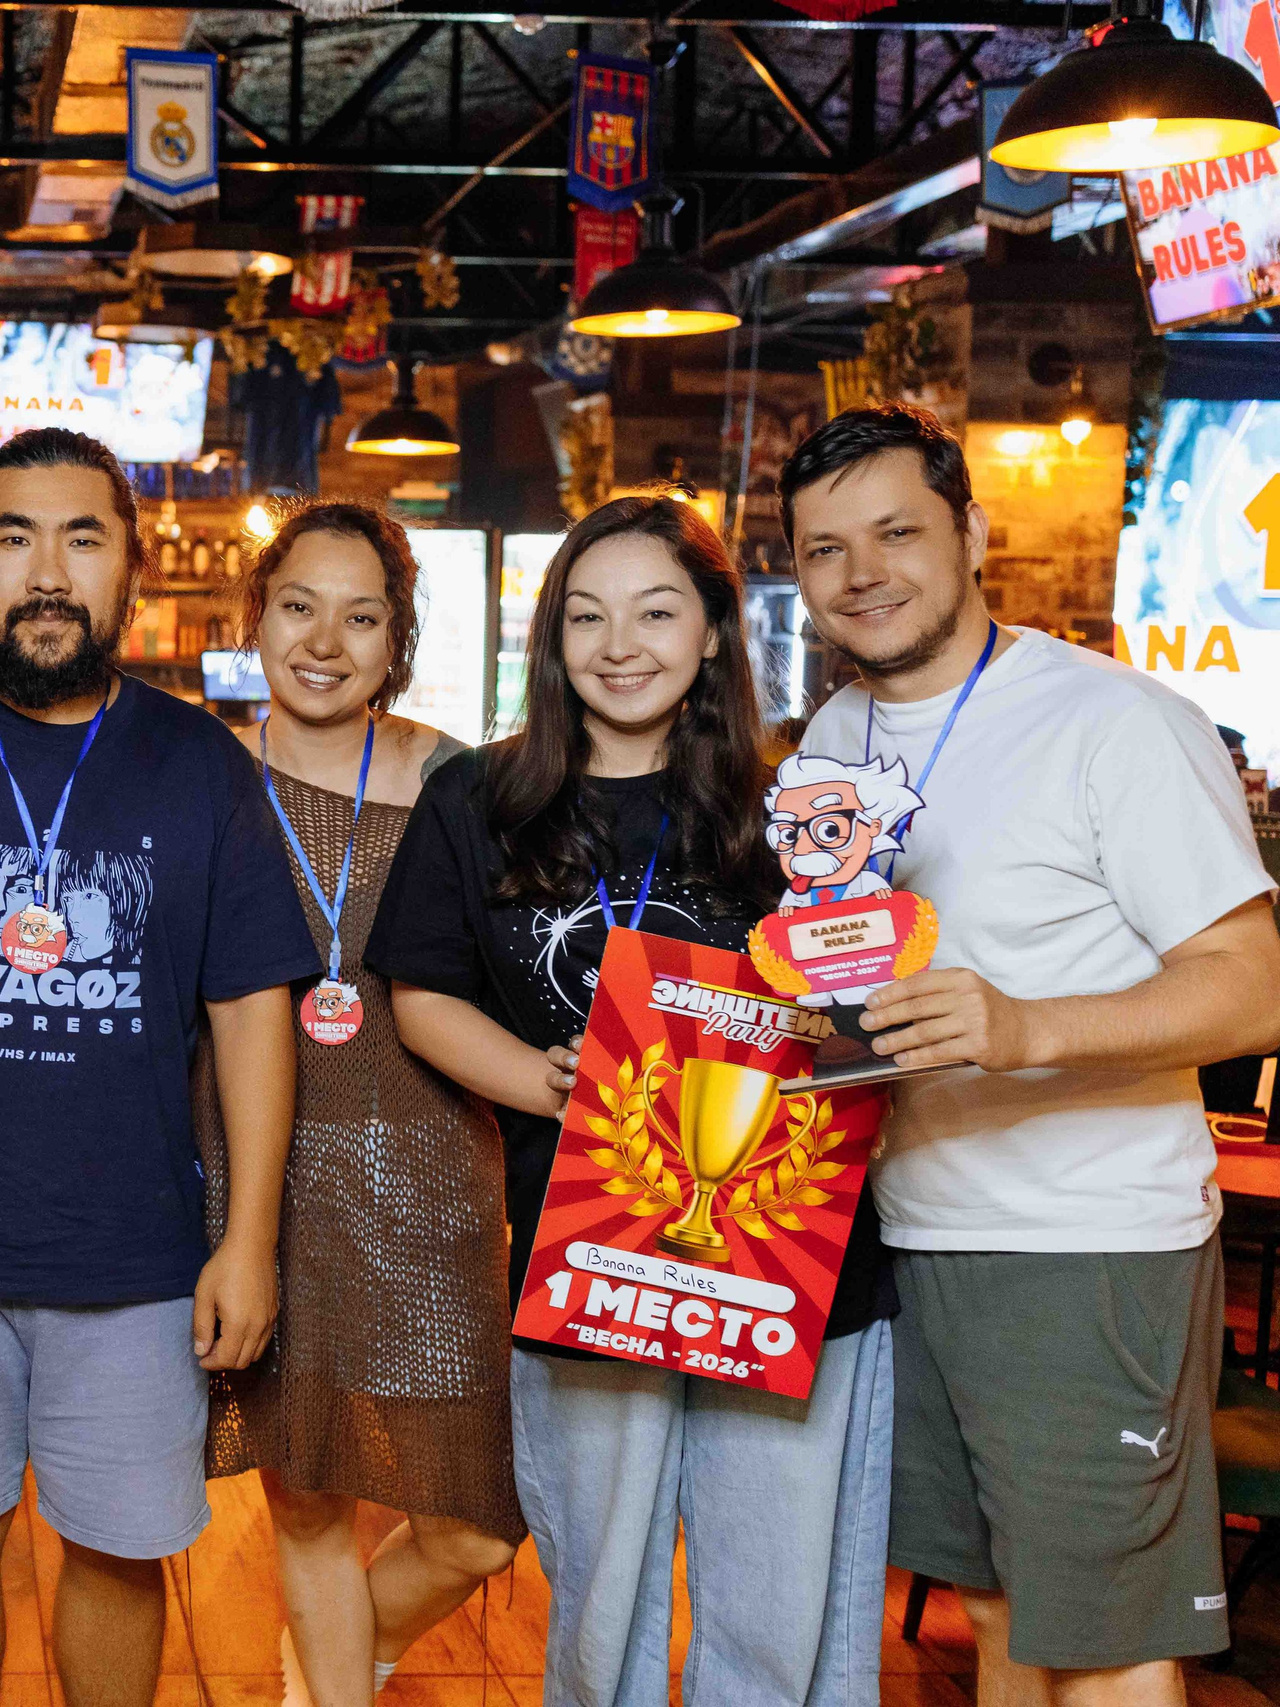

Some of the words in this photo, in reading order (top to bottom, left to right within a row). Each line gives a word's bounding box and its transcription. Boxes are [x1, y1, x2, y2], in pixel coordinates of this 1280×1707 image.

[1137, 147, 1278, 221] BANANA
[1152, 222, 1247, 283] RULES
[142, 836, 154, 849] 5
[810, 919, 871, 938] BANANA
[823, 933, 865, 948] RULES
[6, 946, 13, 956] 1
[14, 947, 59, 964] МЕСТО
[305, 1022, 312, 1032] 1
[314, 1022, 357, 1034] МЕСТО
[701, 1011, 785, 1054] Party
[41, 1051, 76, 1063] IMAX
[586, 1247, 646, 1276] Banana
[663, 1265, 717, 1294] Rules
[545, 1270, 573, 1310] 1
[584, 1278, 796, 1357] МЕСТО
